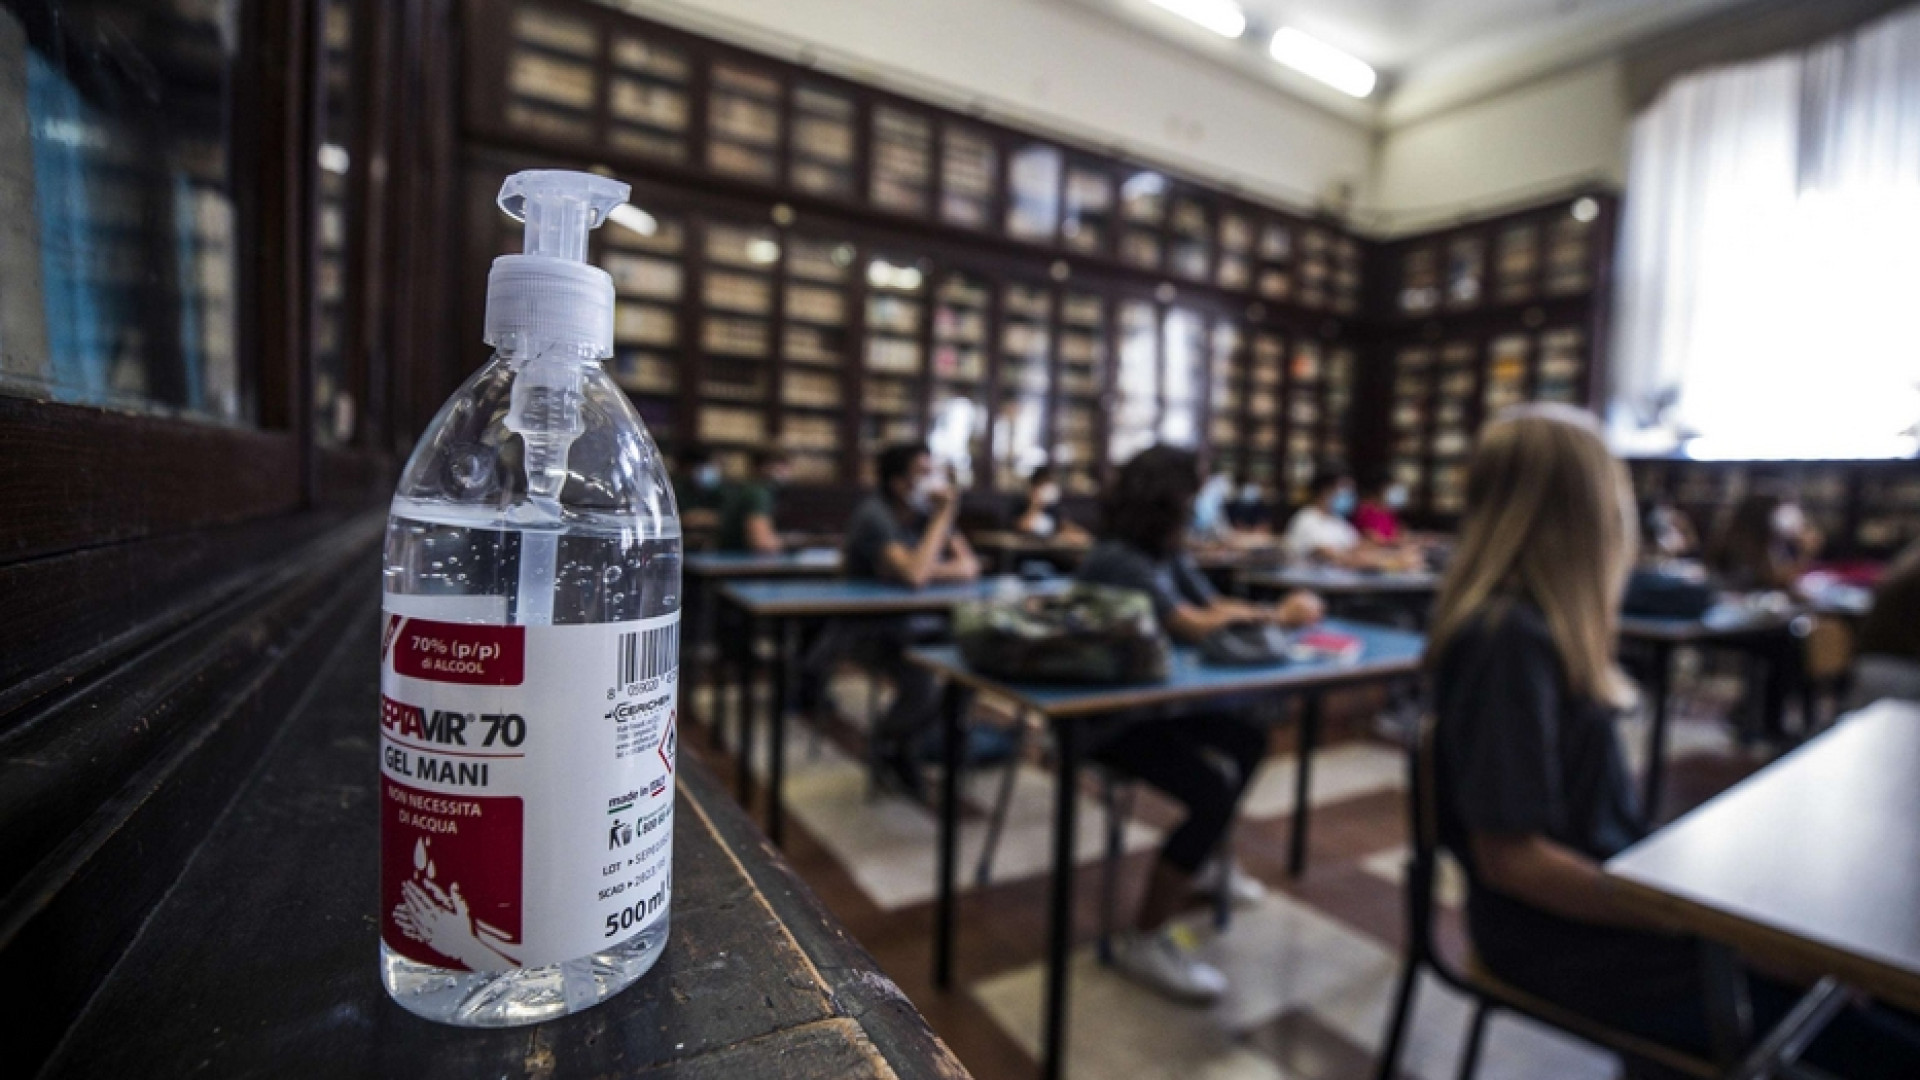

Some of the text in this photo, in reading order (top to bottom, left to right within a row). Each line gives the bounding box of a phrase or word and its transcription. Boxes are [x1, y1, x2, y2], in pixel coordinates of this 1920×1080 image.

[411, 636, 448, 655] 70%
[452, 641, 500, 660] (p/p)
[433, 660, 485, 675] ALCOOL
[479, 713, 526, 748] 70
[385, 745, 488, 786] GEL MANI
[408, 793, 482, 817] NECESSITA
[608, 790, 639, 808] made
[640, 786, 649, 796] in
[399, 809, 458, 834] DI ACQUA
[602, 862, 622, 877] LOT
[604, 880, 666, 938] 500 ml
